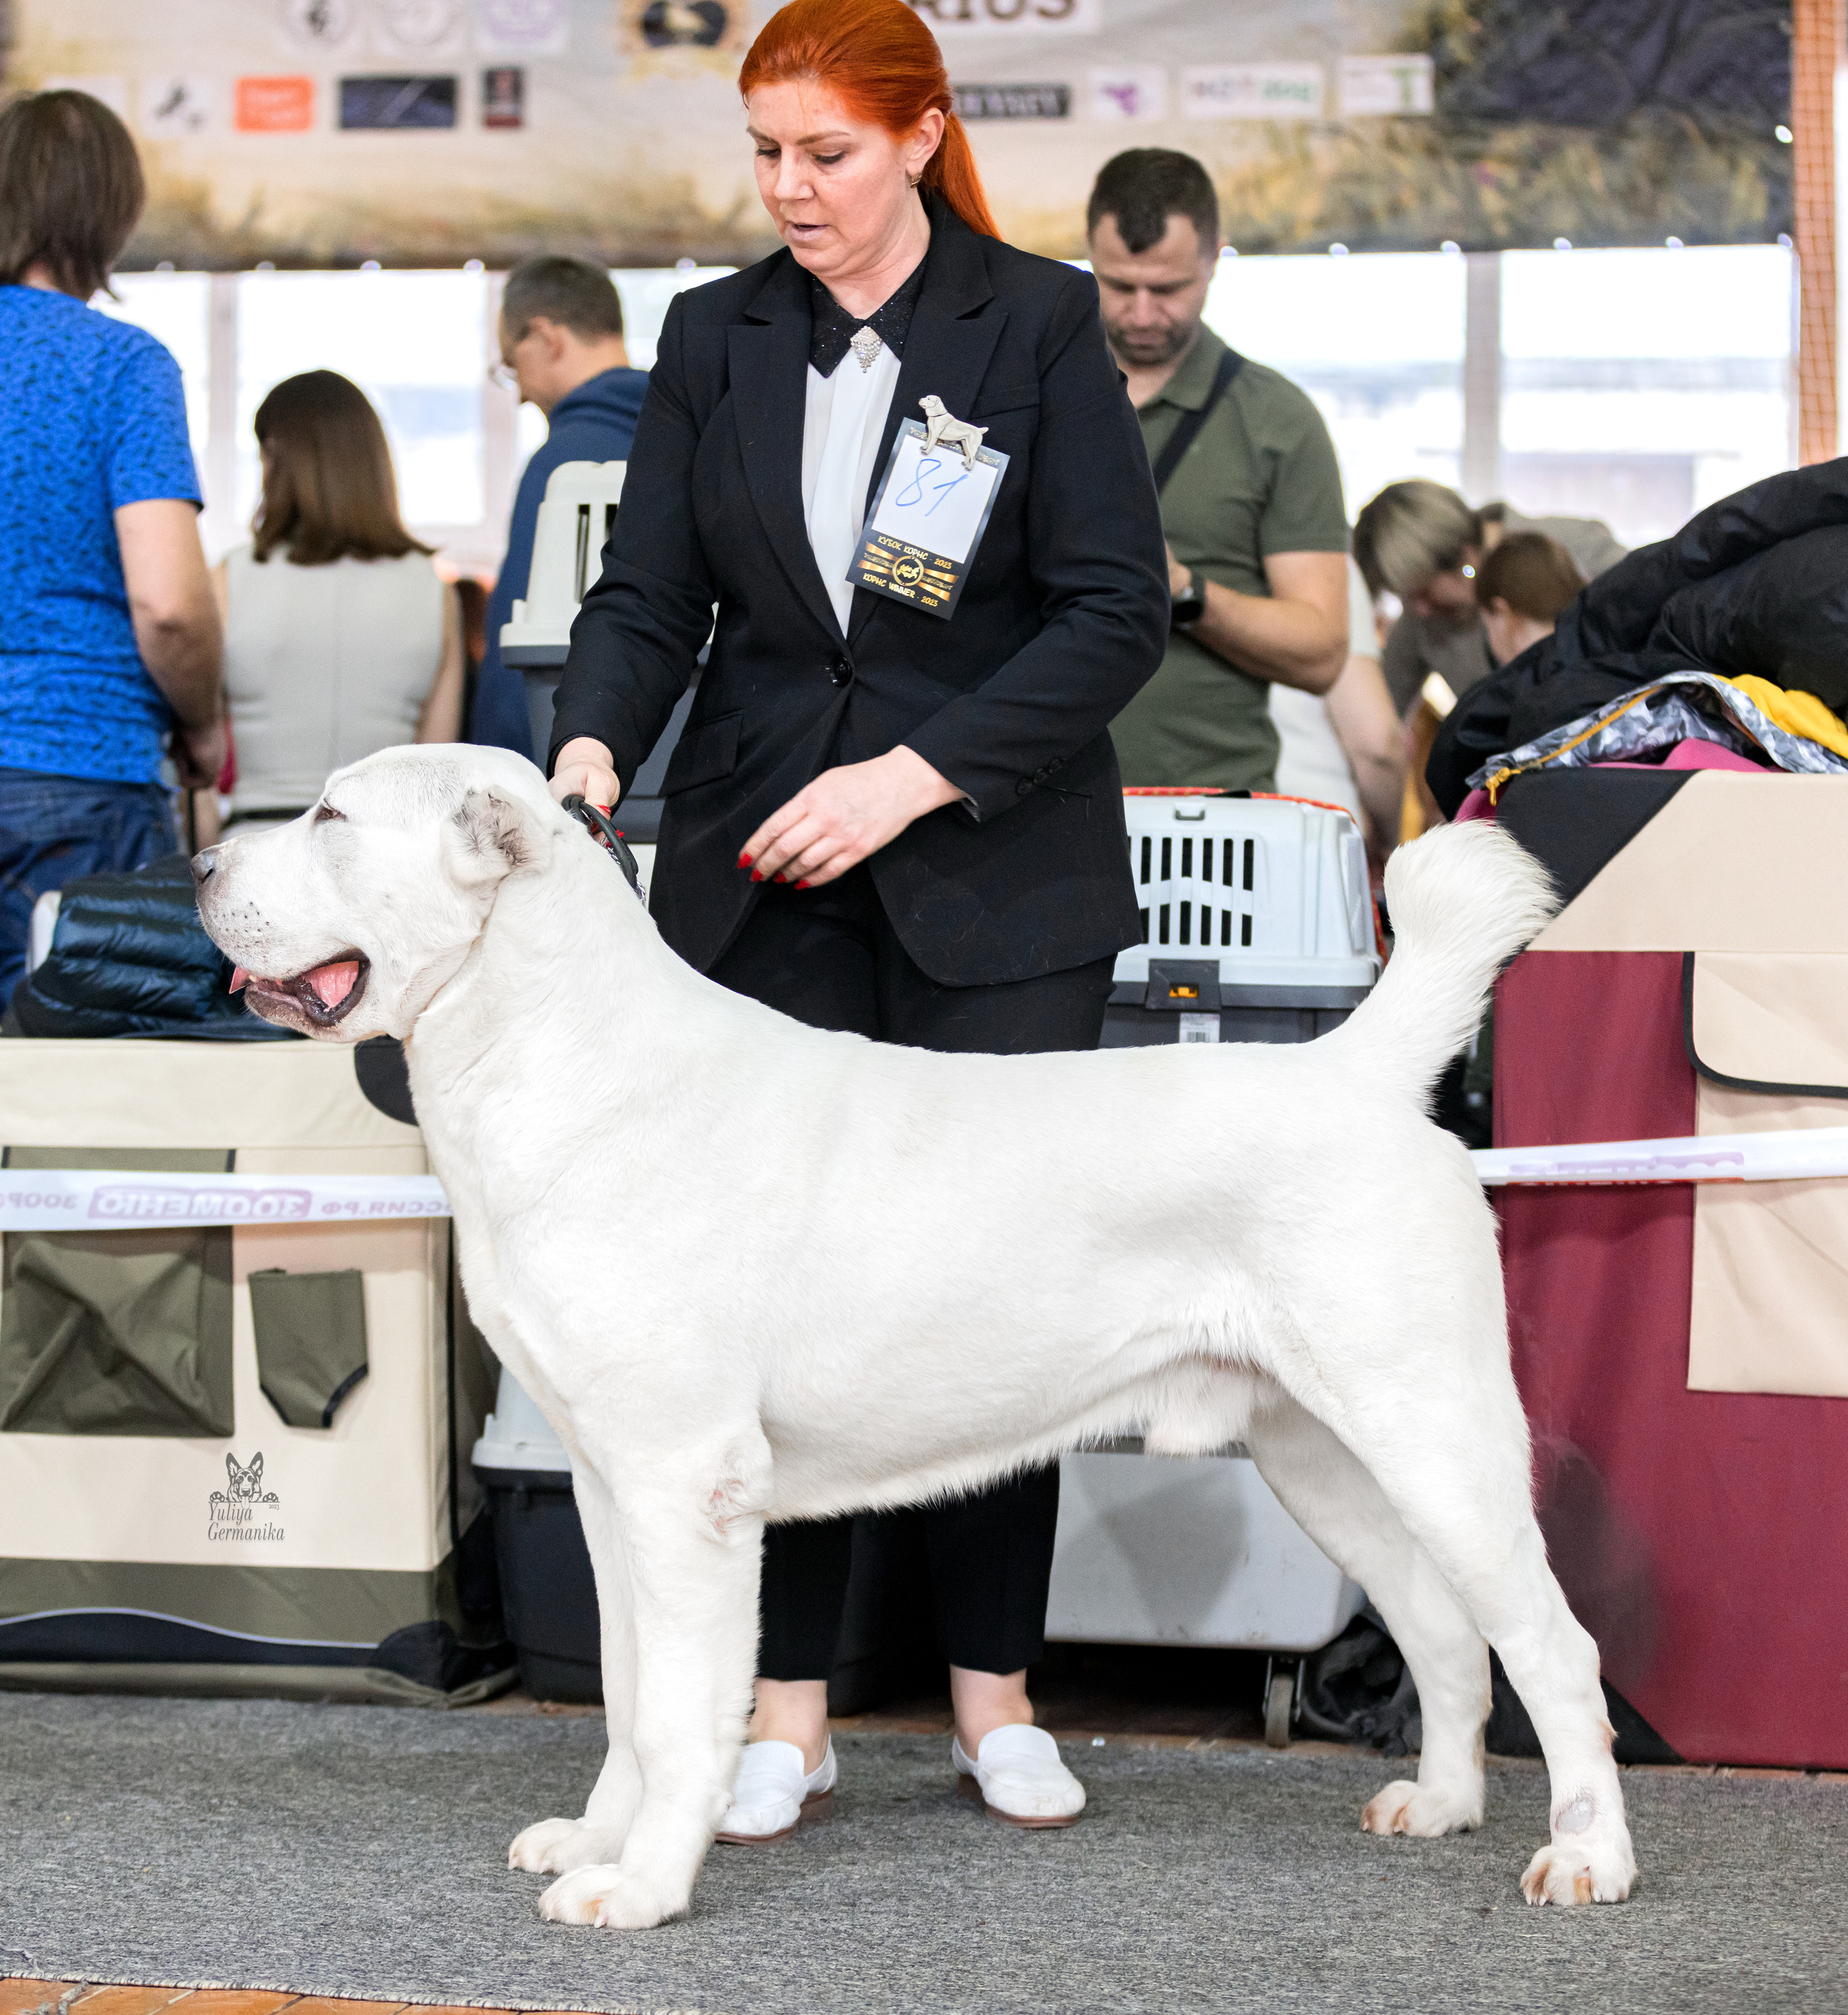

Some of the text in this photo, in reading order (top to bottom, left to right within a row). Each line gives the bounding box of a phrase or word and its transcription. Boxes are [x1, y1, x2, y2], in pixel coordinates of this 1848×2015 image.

[895, 458, 969, 516] 81
[878, 536, 902, 551] КУБОК
[889, 582, 916, 599] WINNER
